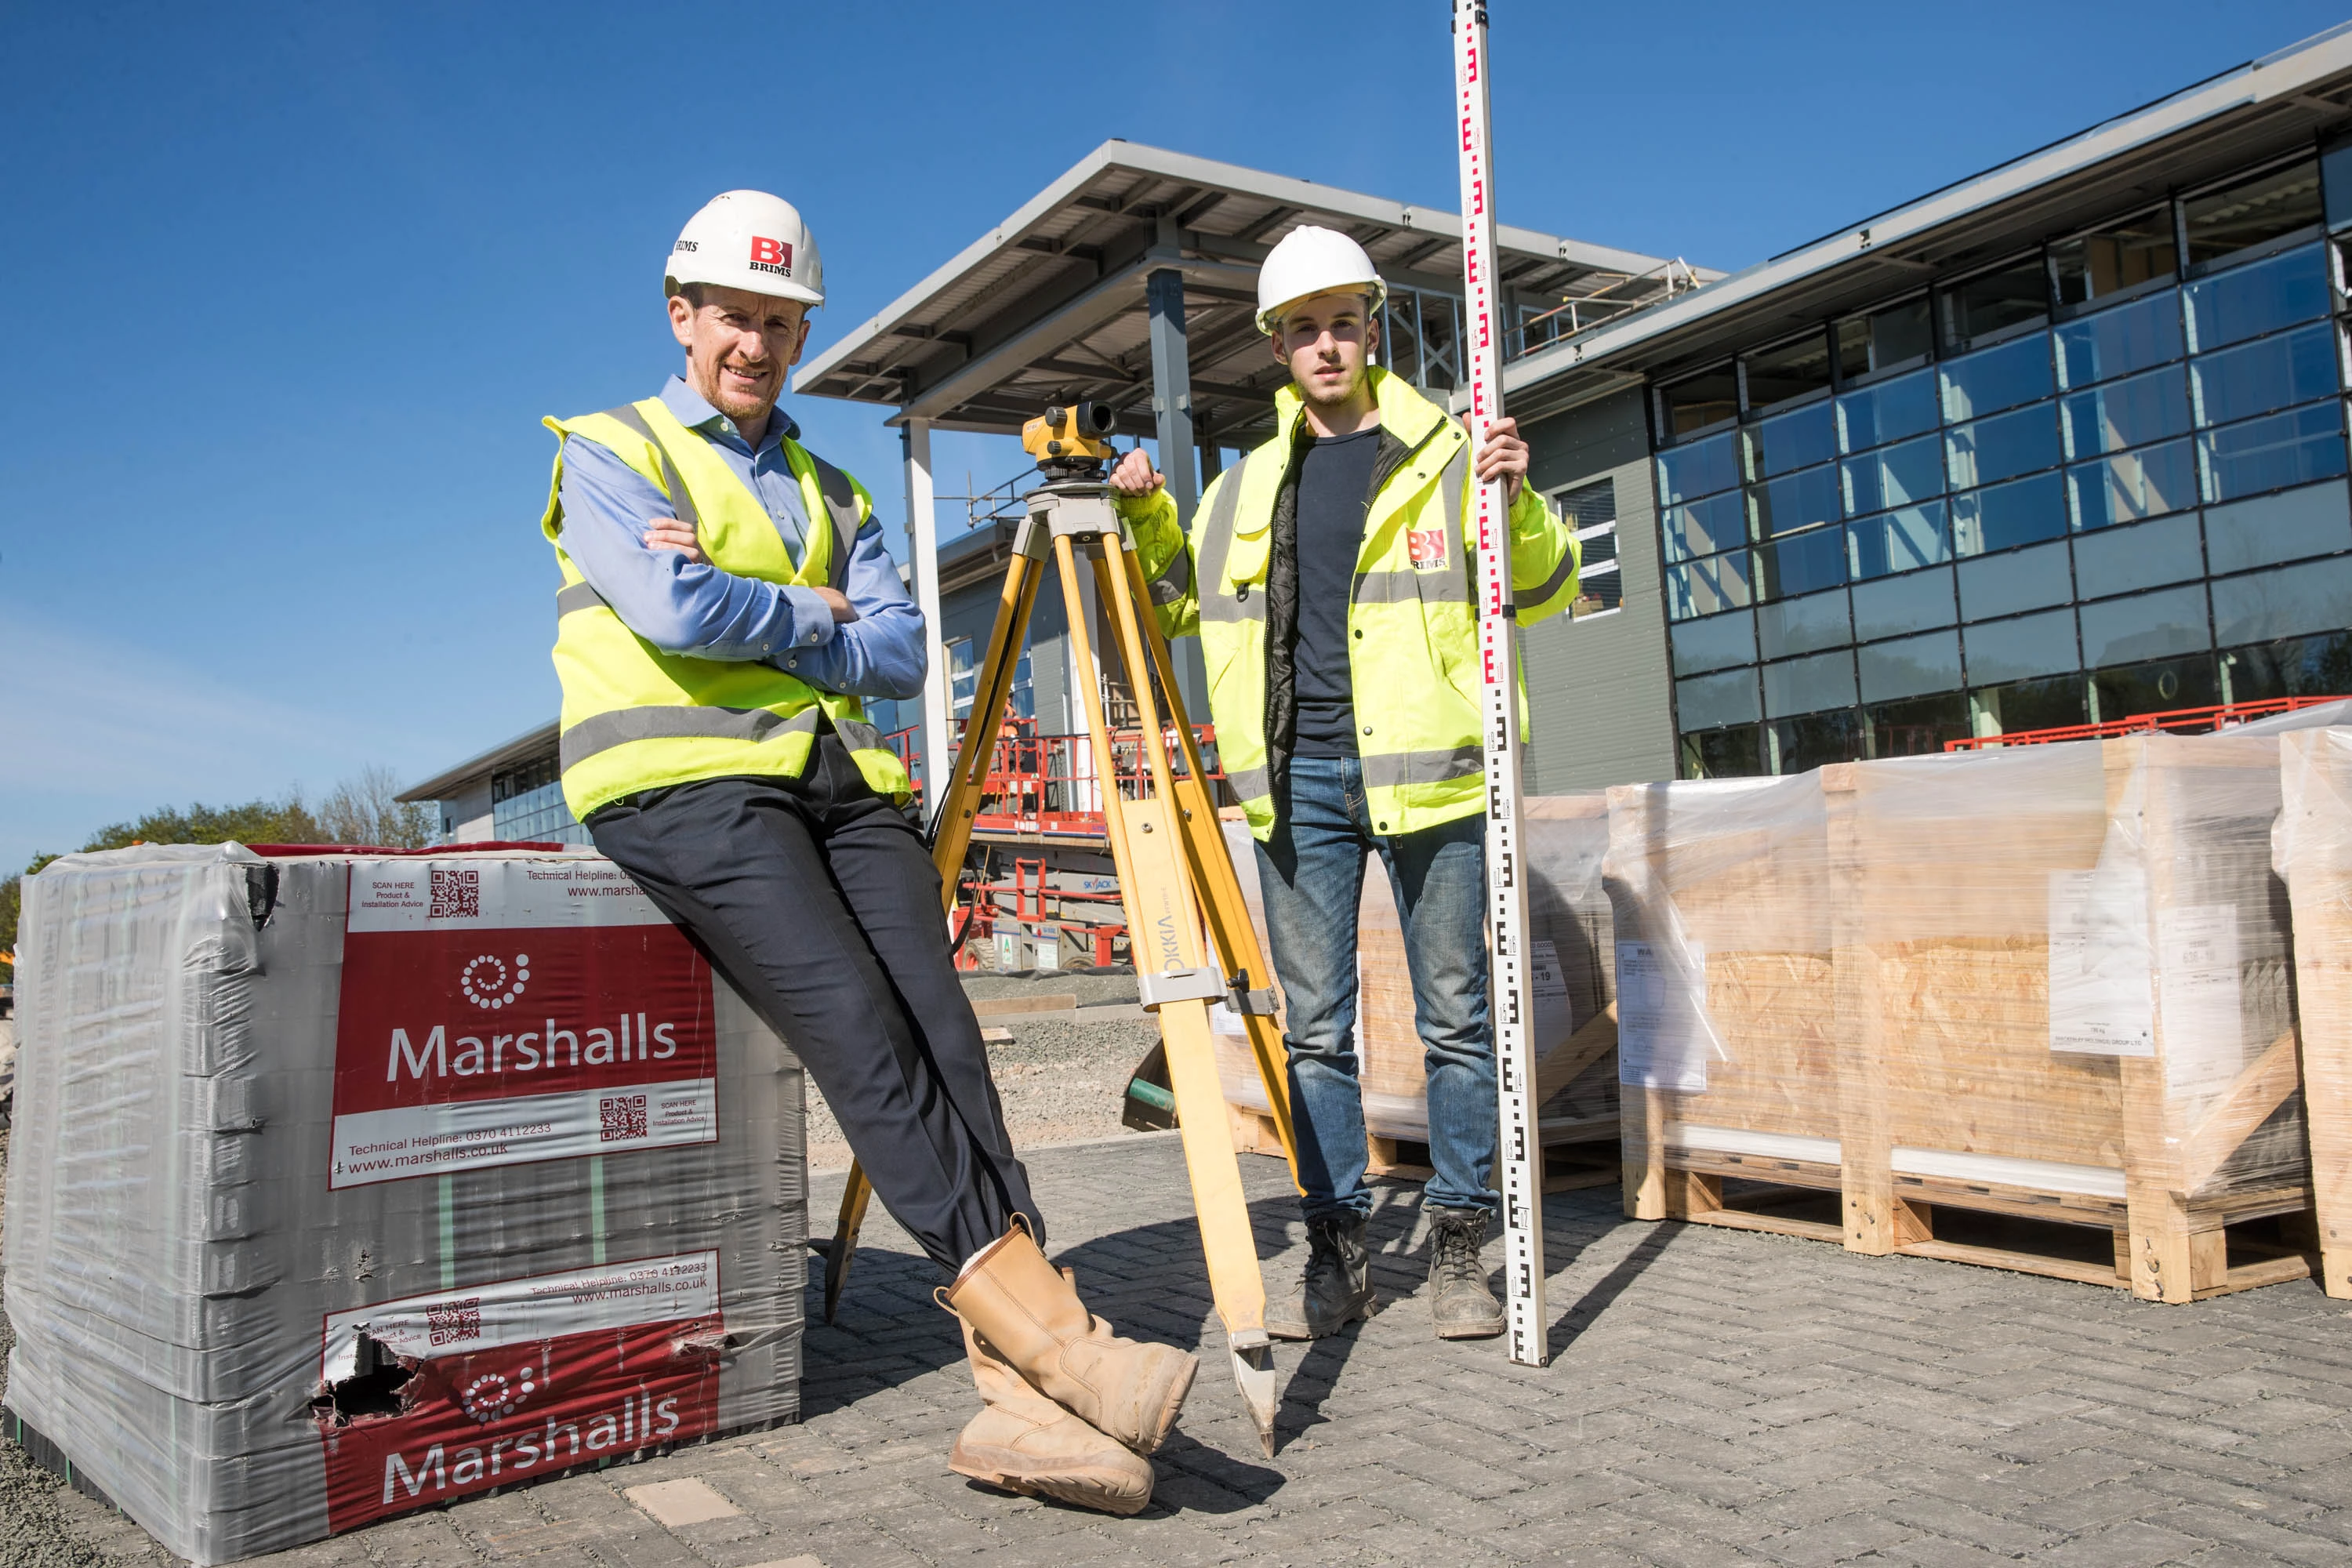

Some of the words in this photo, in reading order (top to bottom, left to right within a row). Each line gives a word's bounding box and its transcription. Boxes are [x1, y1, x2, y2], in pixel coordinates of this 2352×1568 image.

[750, 261, 791, 278] BRIMS
[527, 870, 572, 880] Technical
[575, 870, 616, 882] Helpline:
[1541, 972, 1551, 981] 19
[387, 1012, 677, 1082] Marshalls
[349, 1138, 407, 1156] Technical
[412, 1134, 462, 1150] Helpline:
[466, 1129, 496, 1142] 0370
[500, 1123, 551, 1138] 4112233
[348, 1142, 508, 1174] www.marshalls.co.uk
[531, 1281, 578, 1295] Technical
[582, 1276, 627, 1290] Helpline:
[630, 1269, 658, 1282] 0370
[662, 1262, 707, 1277] 4112233
[572, 1276, 707, 1304] www.marshalls.co.uk
[386, 1319, 408, 1330] HERE
[399, 1334, 421, 1344] Advice
[383, 1392, 680, 1504] Marshalls
